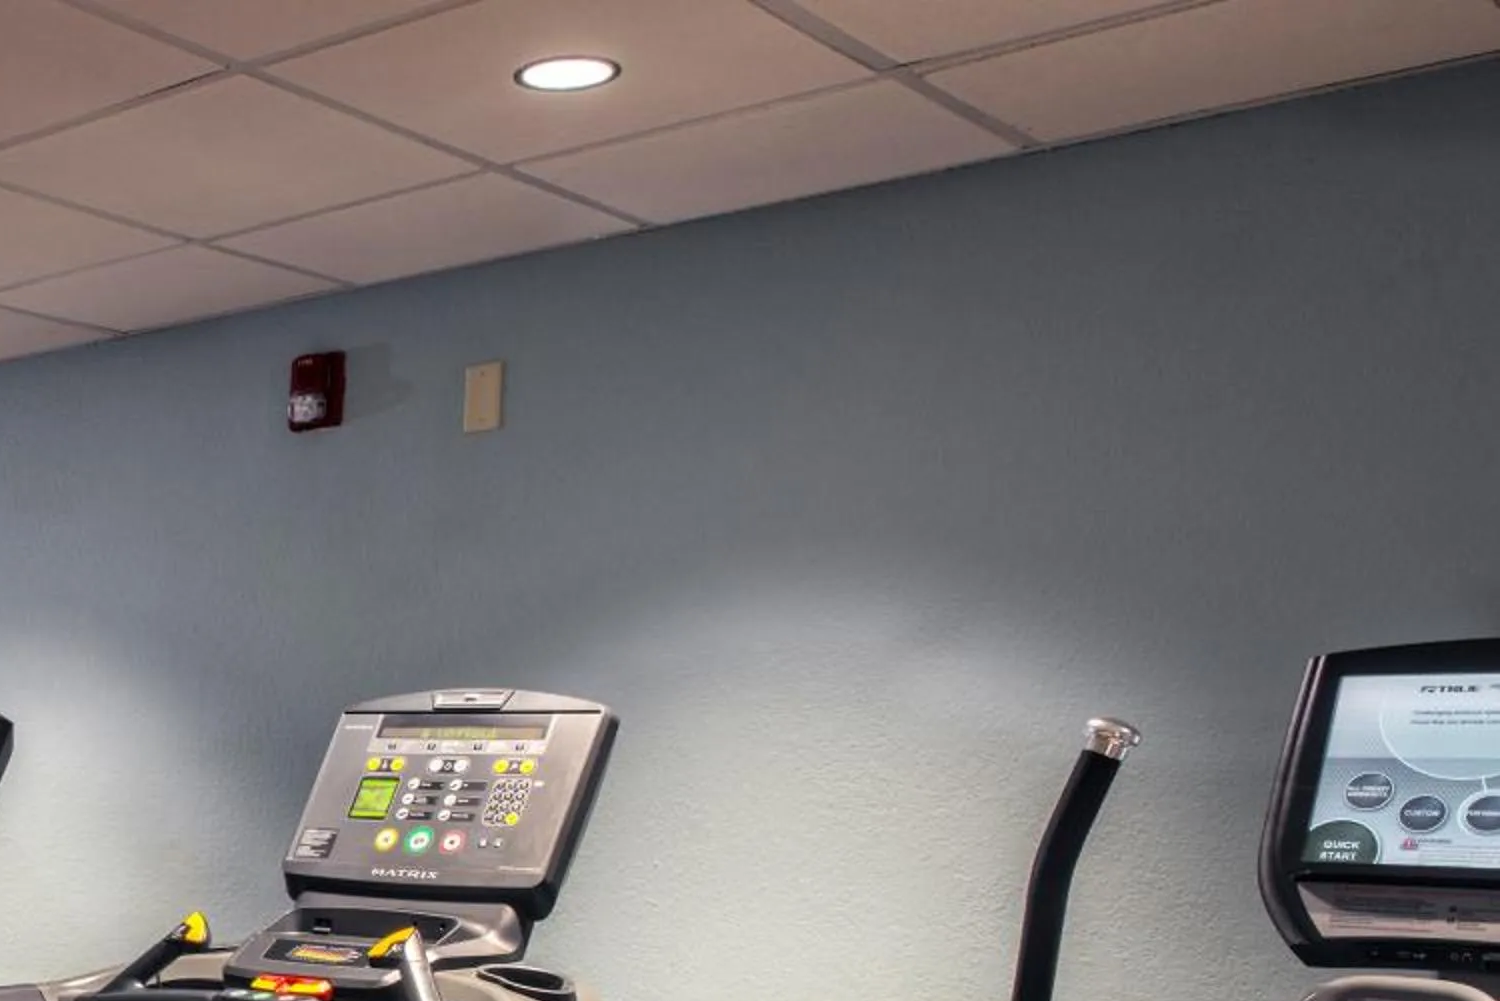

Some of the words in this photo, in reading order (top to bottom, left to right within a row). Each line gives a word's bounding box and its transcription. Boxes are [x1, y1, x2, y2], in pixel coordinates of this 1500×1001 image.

[1323, 840, 1361, 850] QUICK
[1318, 851, 1357, 861] START
[370, 867, 439, 879] MATRIX
